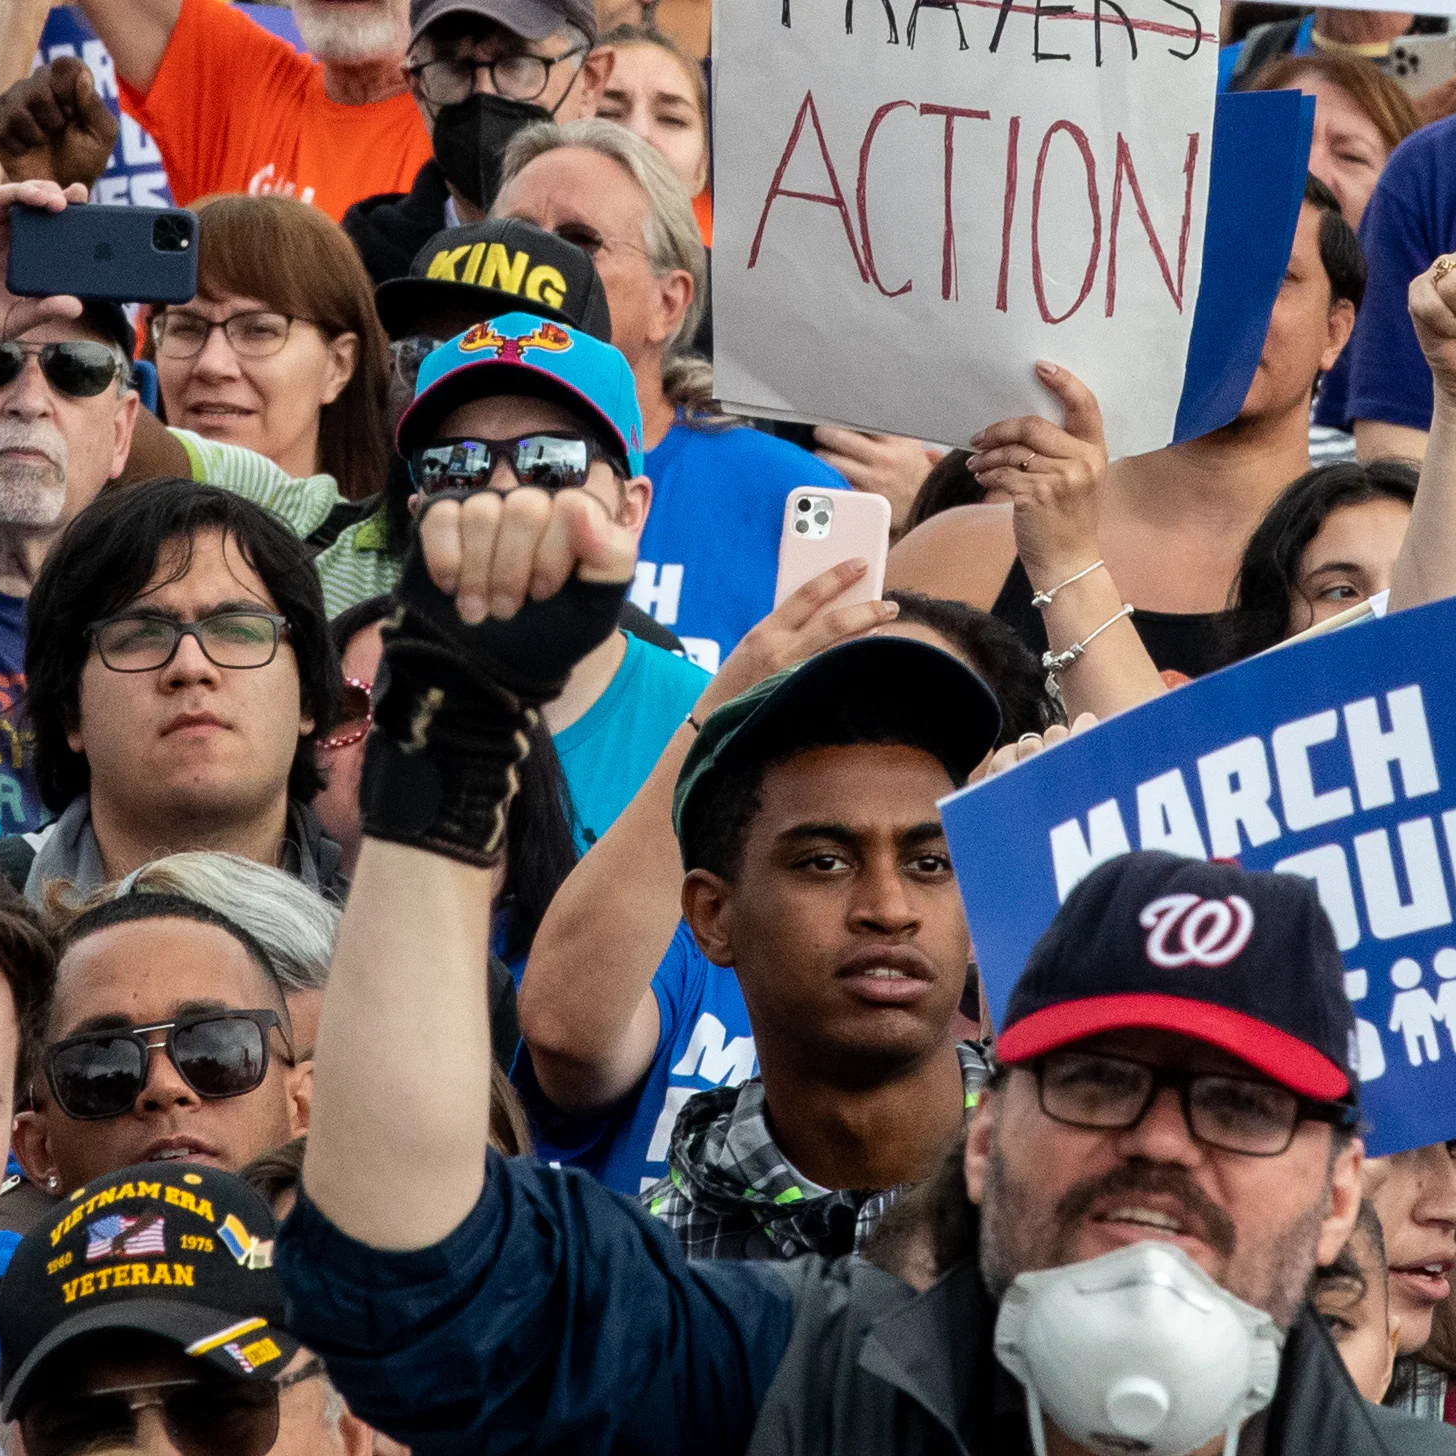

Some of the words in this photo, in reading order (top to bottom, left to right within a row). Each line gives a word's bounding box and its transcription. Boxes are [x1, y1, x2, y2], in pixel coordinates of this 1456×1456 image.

[747, 88, 1202, 326] ACTION
[426, 241, 568, 311] KING
[1047, 682, 1443, 906] MARCH
[1139, 891, 1255, 969] W
[49, 1179, 163, 1248] VIETNAM
[164, 1184, 216, 1224] ERA
[178, 1233, 215, 1254] 1975
[61, 1262, 196, 1305] VETERAN
